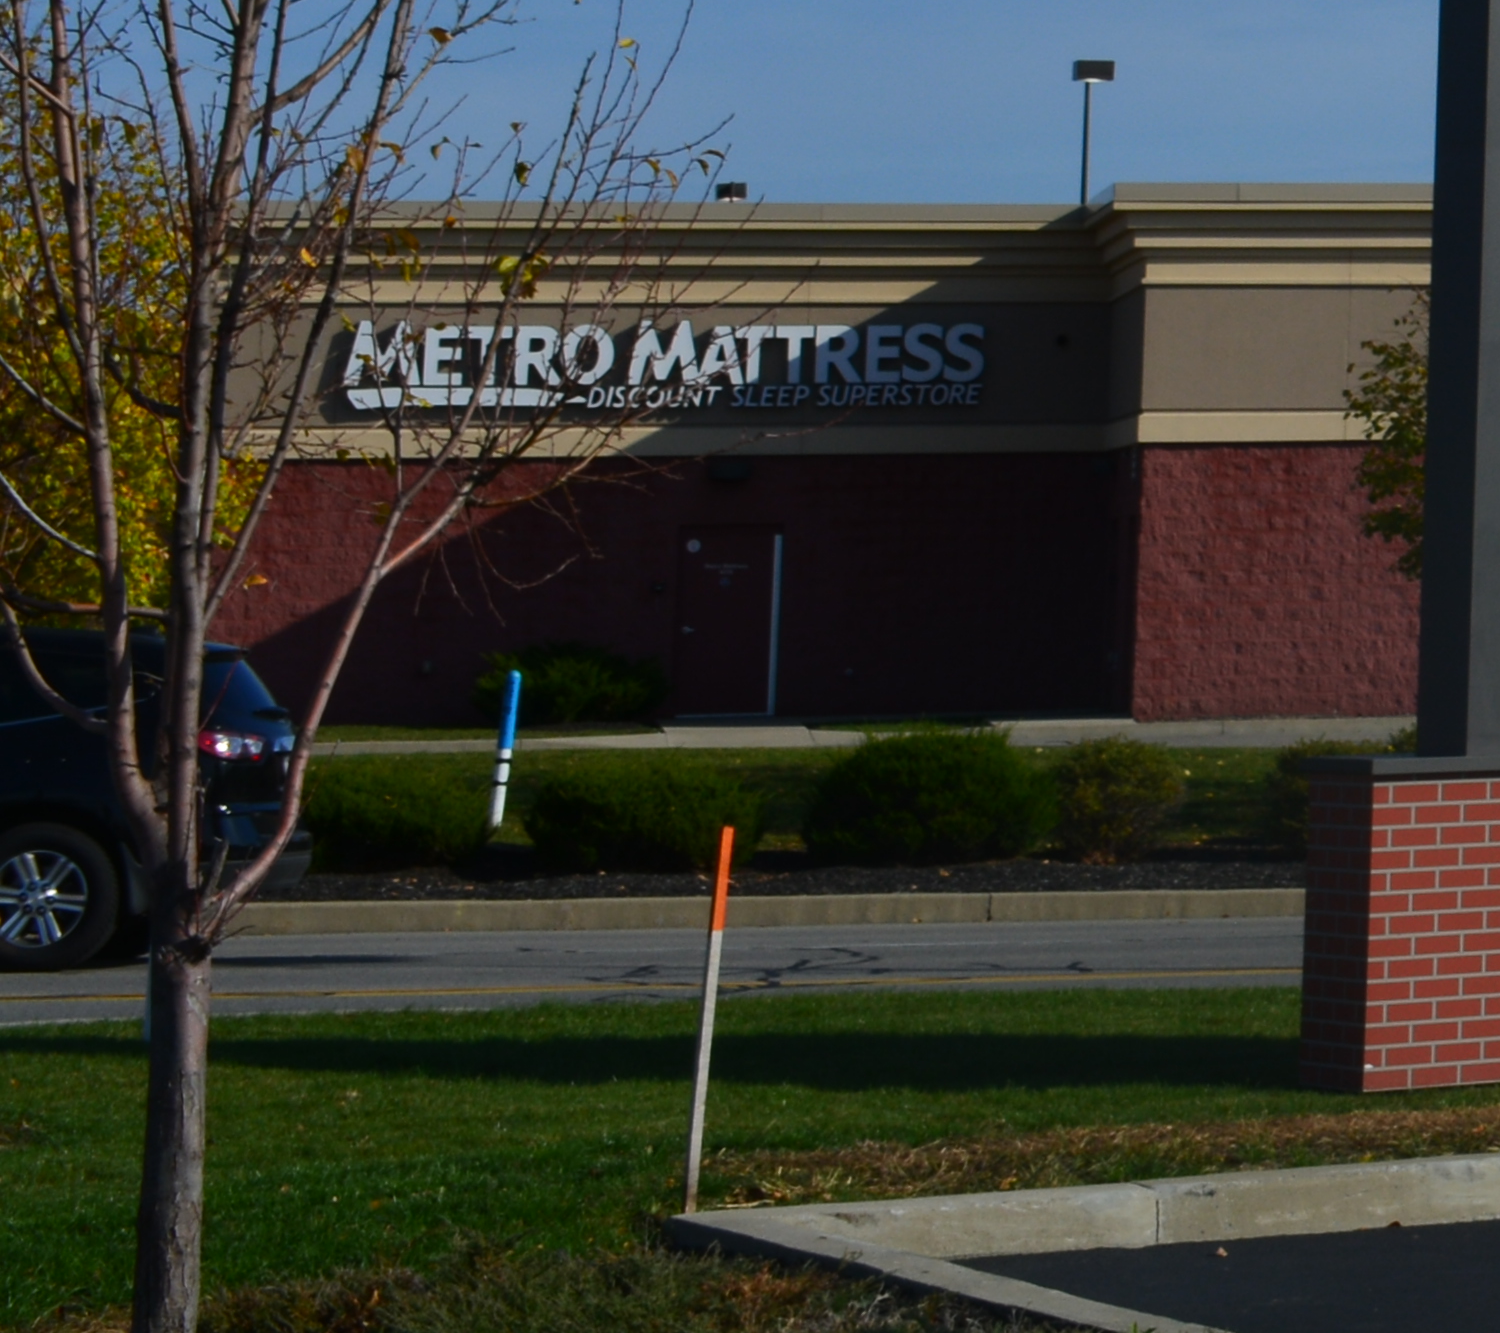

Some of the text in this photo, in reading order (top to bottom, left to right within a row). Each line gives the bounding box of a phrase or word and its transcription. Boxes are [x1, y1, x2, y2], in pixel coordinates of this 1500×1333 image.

[343, 320, 984, 386] METRO MATTRESS
[587, 383, 983, 408] DISCOUNT SLEEP SUPERSTORE
